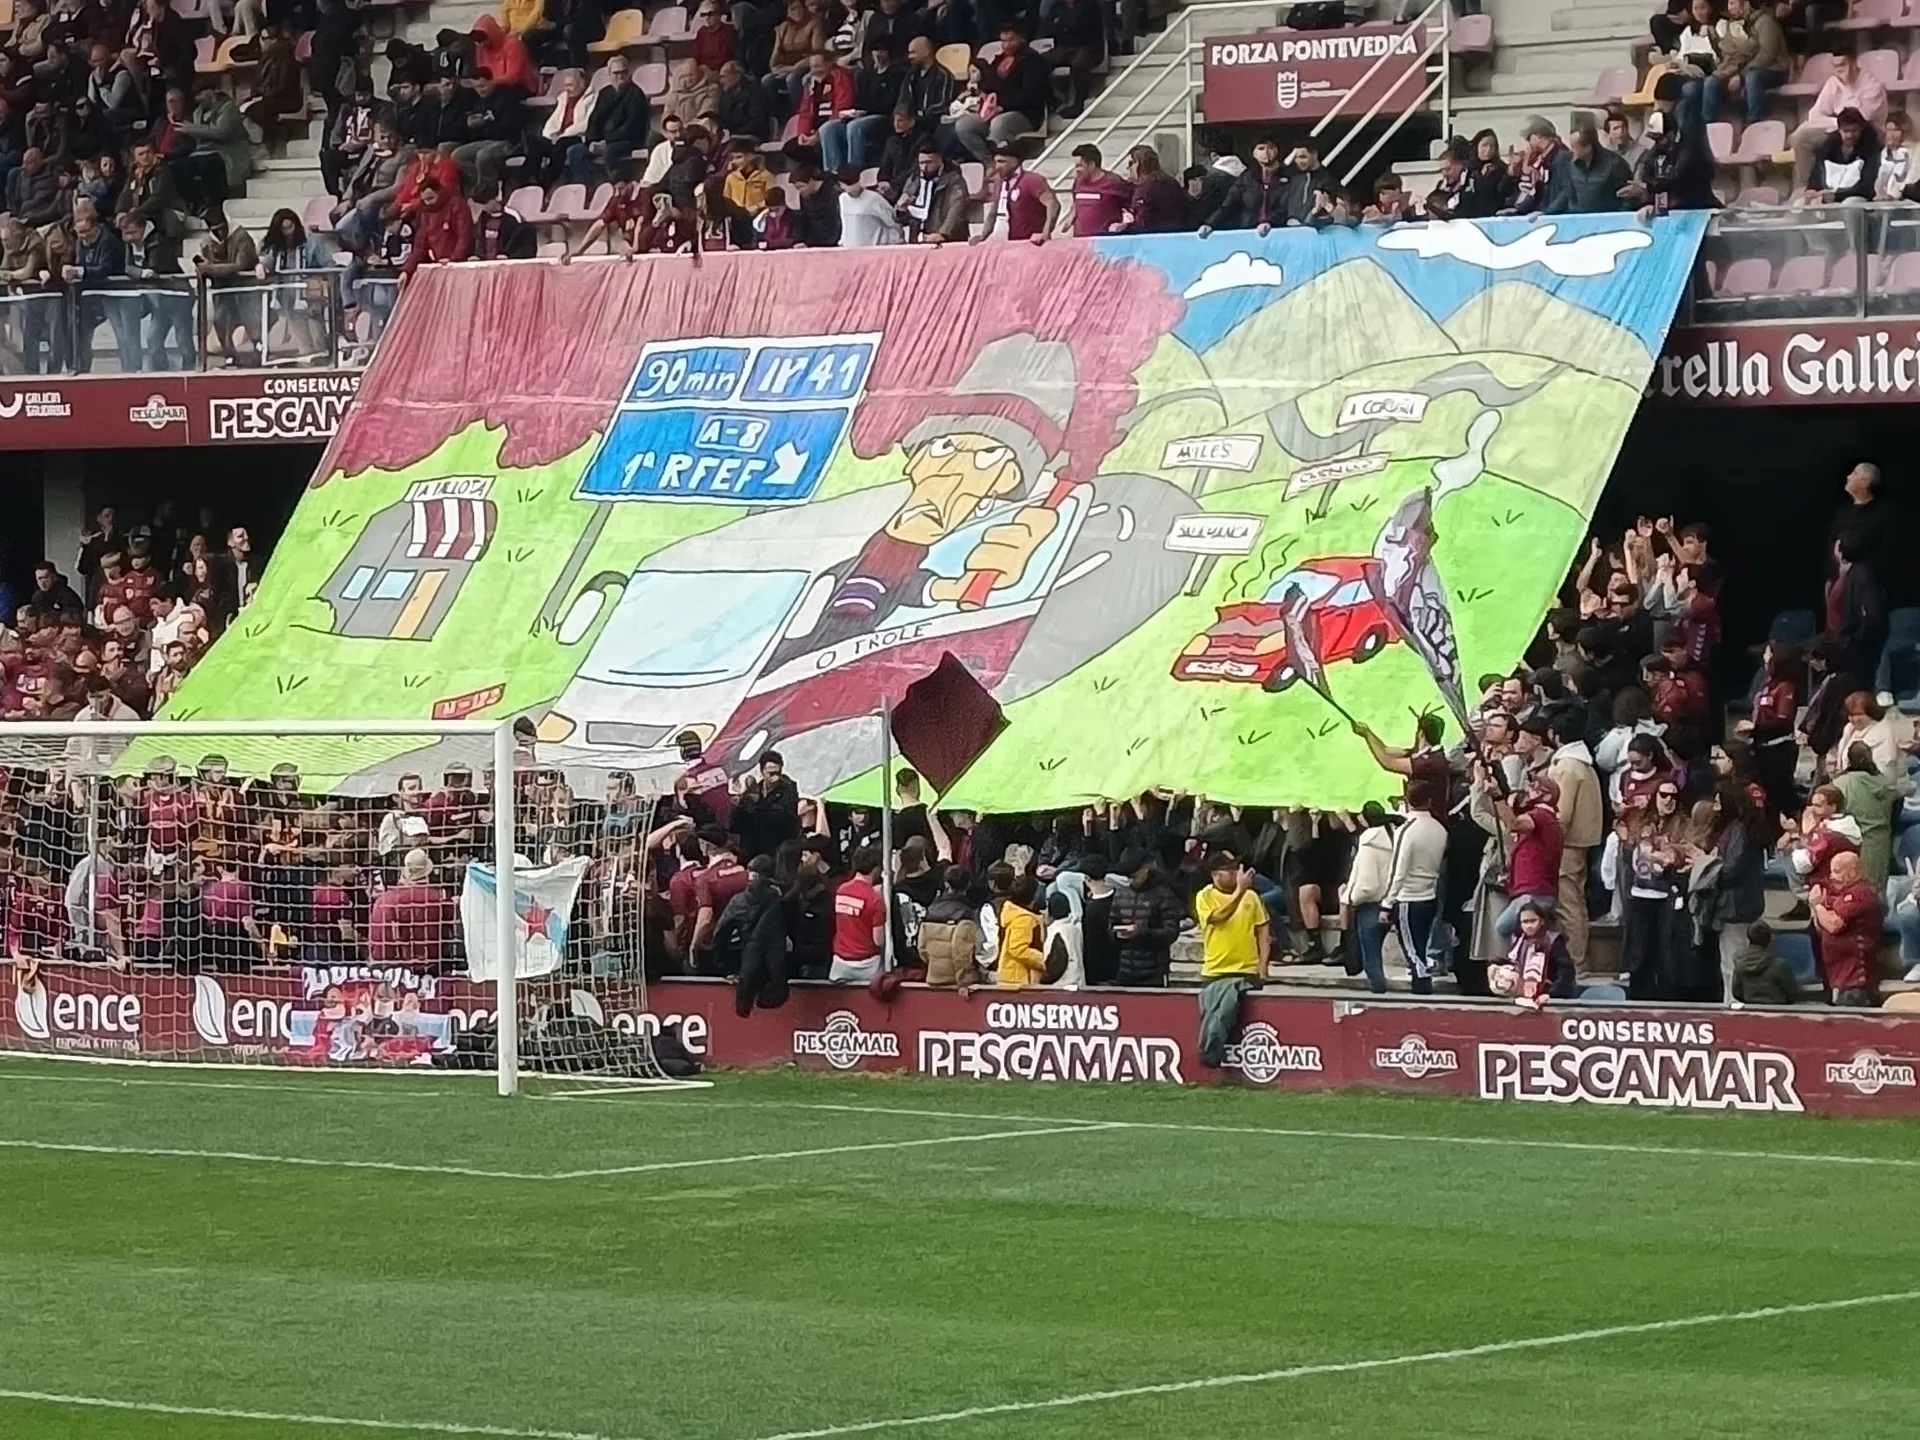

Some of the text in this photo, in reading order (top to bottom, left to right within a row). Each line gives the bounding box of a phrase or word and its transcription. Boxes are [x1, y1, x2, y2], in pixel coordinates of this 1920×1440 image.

[1212, 42, 1278, 65] FORZA
[1659, 332, 1920, 398] rella Galic
[263, 377, 361, 394] CONSERVAS
[209, 397, 352, 439] PESCAM
[701, 421, 764, 447] A-8
[659, 453, 767, 492] RFEF
[816, 650, 836, 670] O
[54, 993, 141, 1032] ence
[986, 1002, 1120, 1031] CONSERVAS
[793, 1030, 900, 1057] PESCAMAR
[1562, 1019, 1714, 1044] CONSERVAS
[919, 1030, 1184, 1084] PESCAMAR
[1222, 1043, 1323, 1072] ESCAMAR
[1375, 1048, 1459, 1070] PESCAMAR
[1478, 1043, 1805, 1112] PESCAMAR
[1826, 1063, 1917, 1086] PESCAMAR
